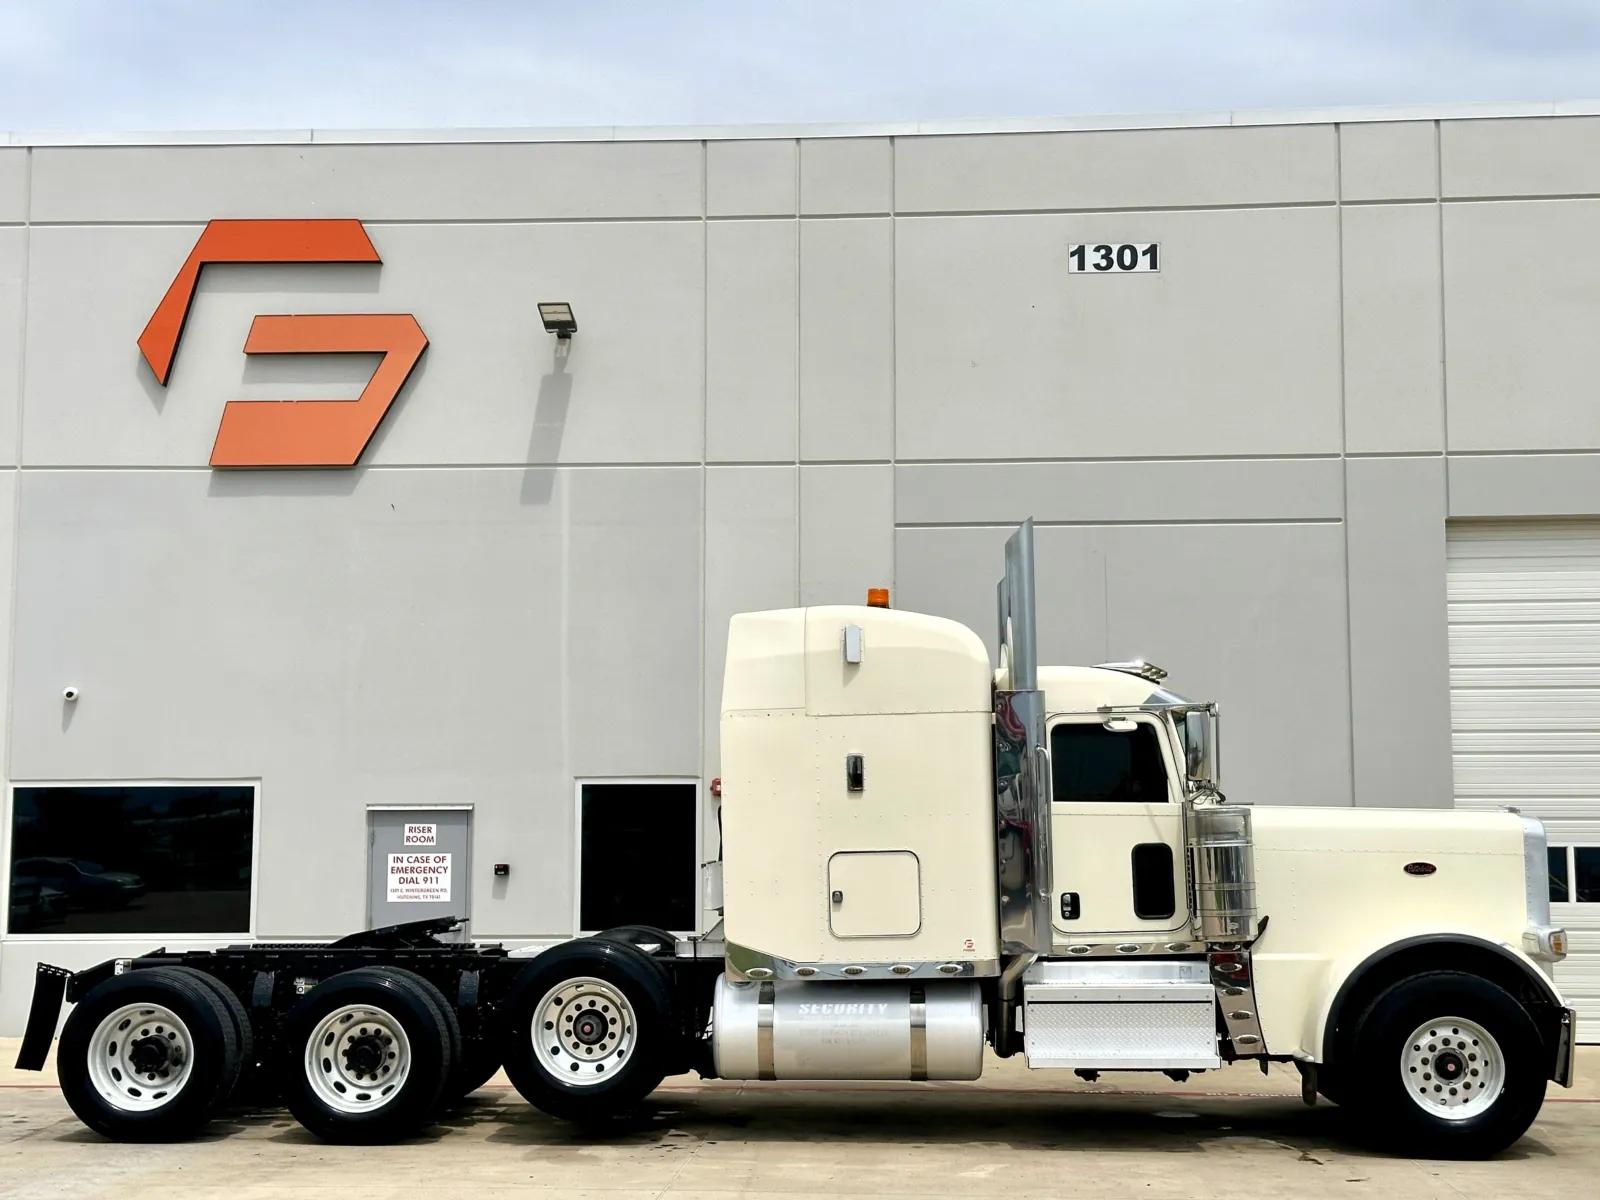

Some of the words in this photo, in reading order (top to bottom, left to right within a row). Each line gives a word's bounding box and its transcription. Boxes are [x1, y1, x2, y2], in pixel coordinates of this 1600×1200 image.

[1070, 244, 1158, 271] 1301
[408, 826, 433, 834] RISER
[405, 835, 435, 843] ROOM
[393, 856, 404, 864] IN
[406, 856, 431, 864] CASE
[433, 856, 447, 864] OF
[390, 866, 449, 874] EMERGENCY
[398, 877, 420, 885] DIAL
[422, 877, 439, 885] 911
[798, 1003, 888, 1015] SECURITY
